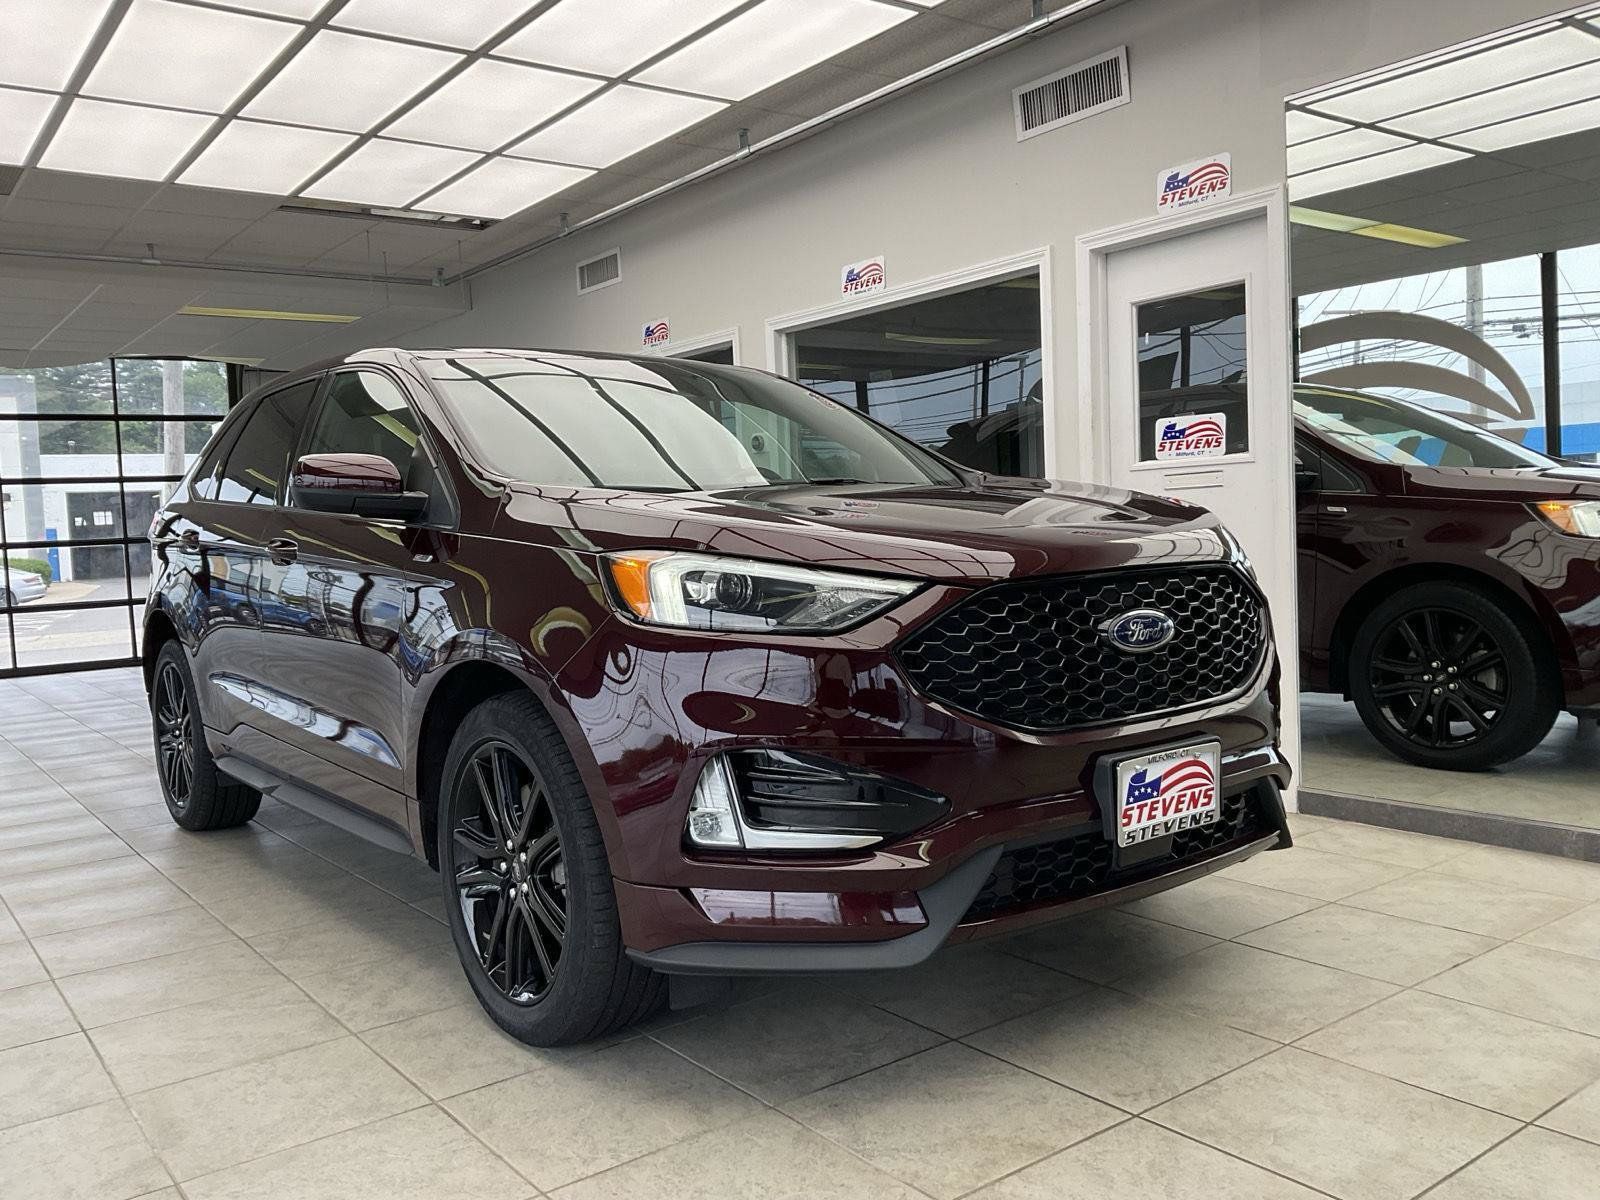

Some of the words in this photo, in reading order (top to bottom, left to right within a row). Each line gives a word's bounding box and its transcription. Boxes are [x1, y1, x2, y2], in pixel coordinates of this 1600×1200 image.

[1159, 177, 1229, 206] STEVENS
[842, 274, 883, 294] STEVENS
[642, 332, 668, 346] STEVENS
[1158, 437, 1223, 453] STEVENS
[1127, 618, 1162, 641] Ford
[1180, 749, 1189, 758] CT
[1121, 786, 1215, 828] STEVENS
[1125, 809, 1215, 845] STEVENS
